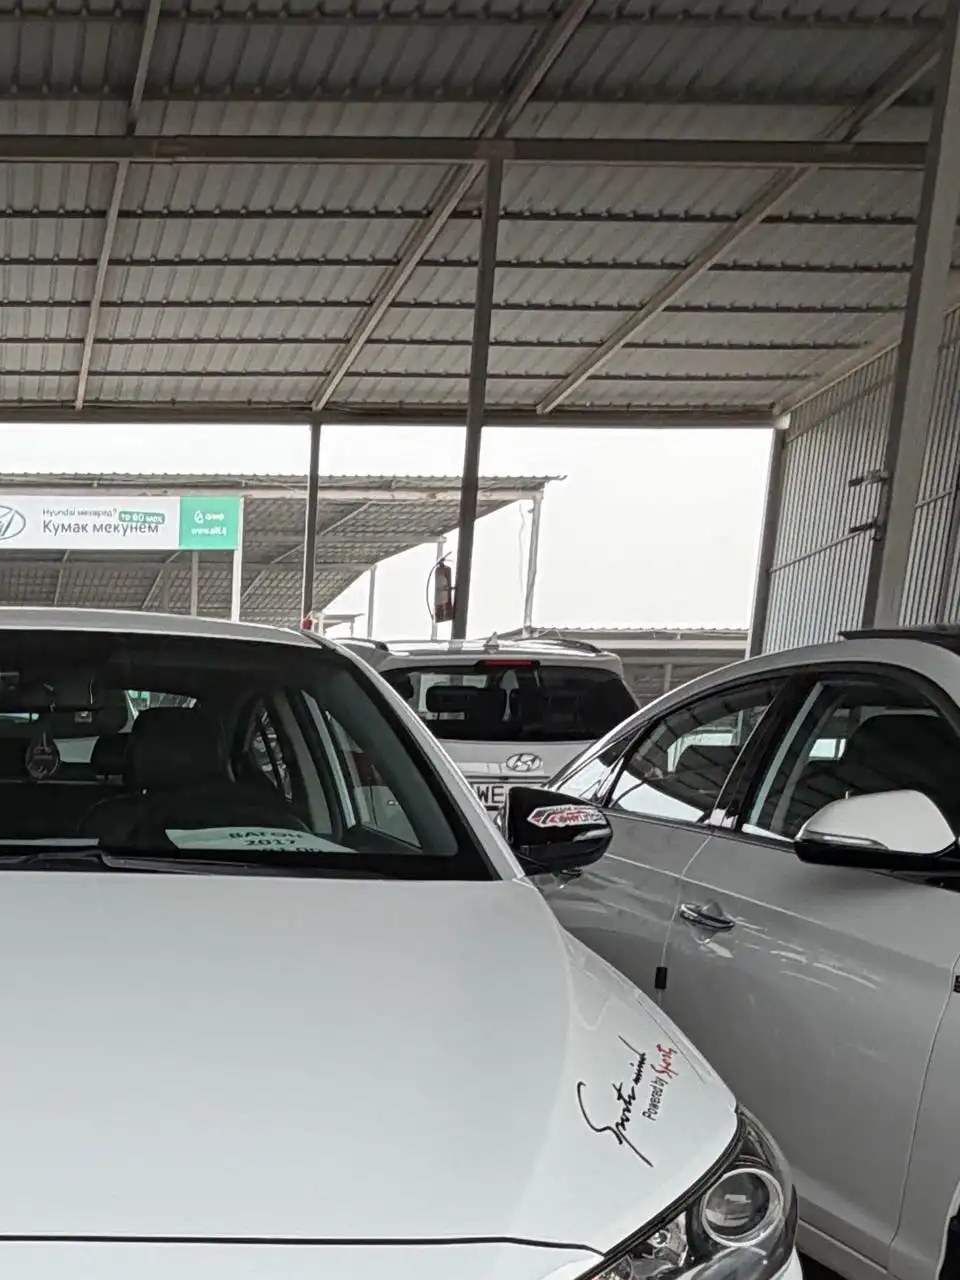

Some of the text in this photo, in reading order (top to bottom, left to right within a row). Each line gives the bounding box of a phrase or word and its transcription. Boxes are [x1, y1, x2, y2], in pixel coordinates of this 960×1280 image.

[43, 519, 160, 536] Кумак мекунем
[642, 1084, 664, 1121] Powered
